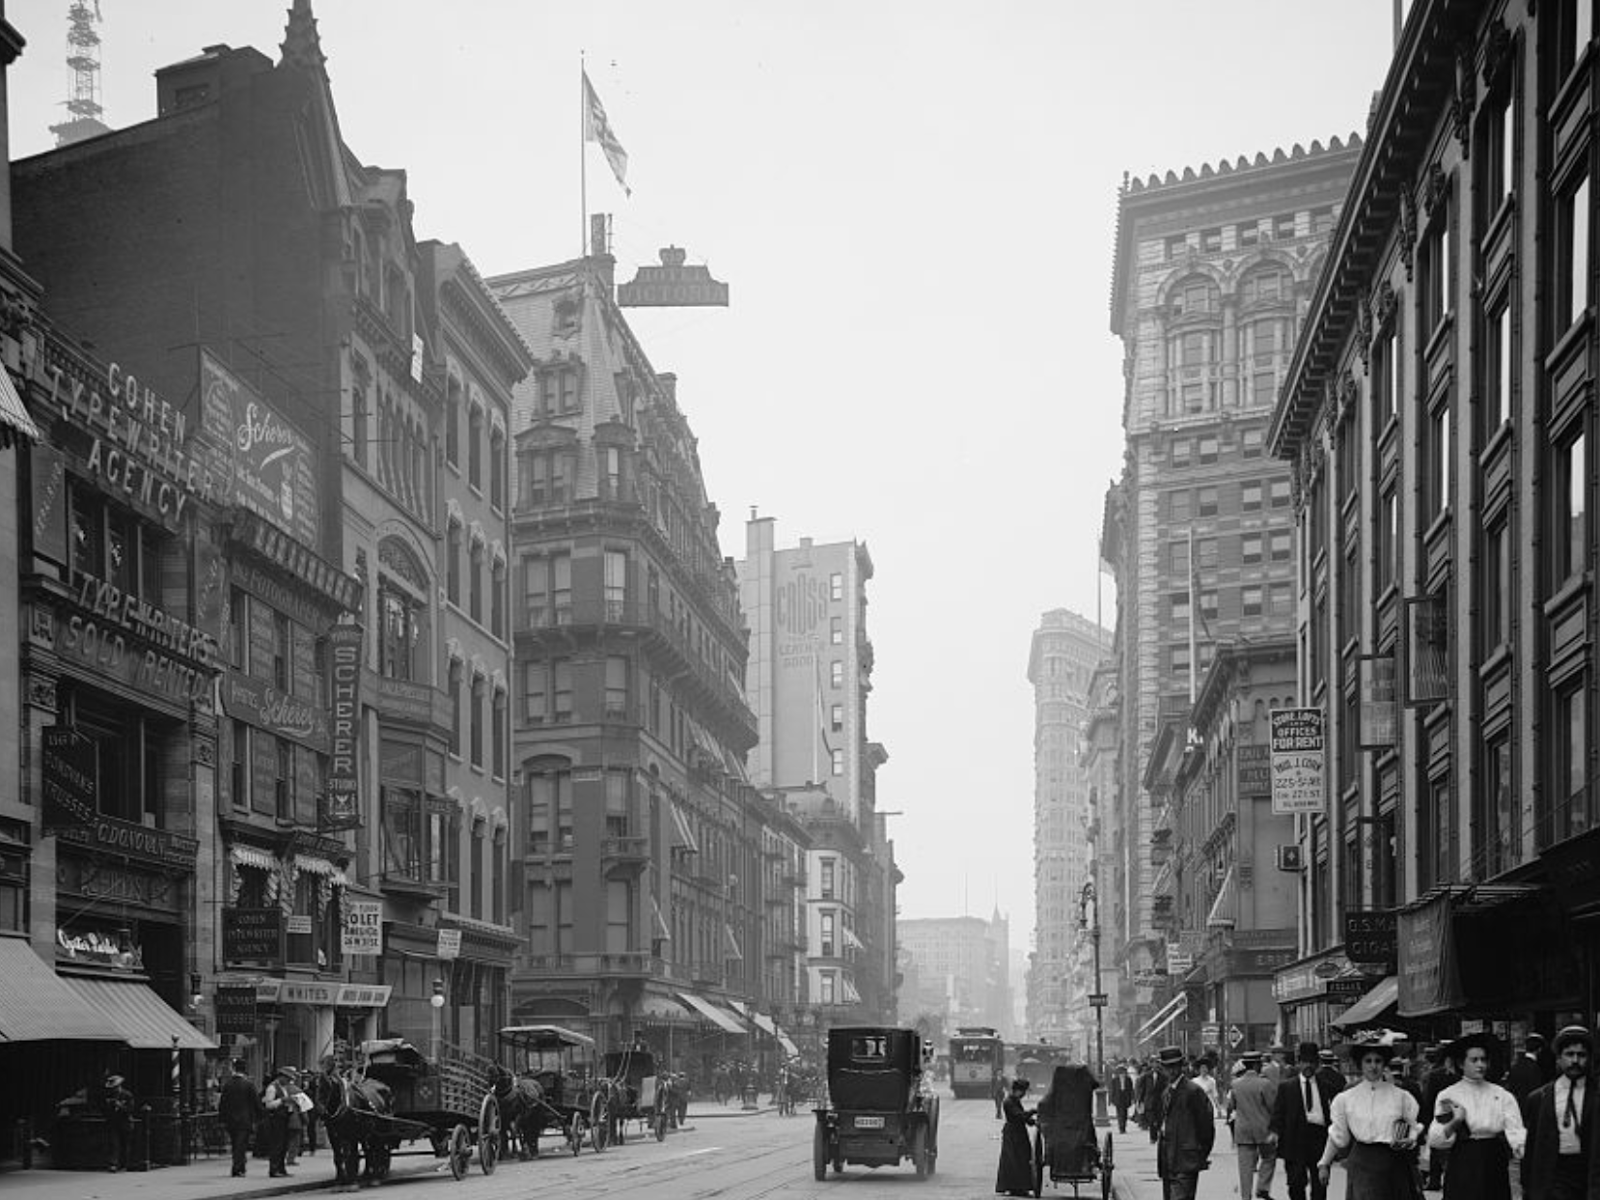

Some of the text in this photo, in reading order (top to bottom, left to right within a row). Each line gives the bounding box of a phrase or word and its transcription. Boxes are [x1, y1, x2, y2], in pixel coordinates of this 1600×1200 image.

[50, 364, 214, 503] TYPEWRITER
[108, 363, 186, 444] COHEN
[87, 439, 187, 522] AGENCY
[66, 616, 125, 666] SOLD
[333, 647, 356, 772] SCHERER
[1277, 727, 1316, 737] OFFICES
[1273, 737, 1320, 749] FOR RENT
[360, 914, 378, 926] LET
